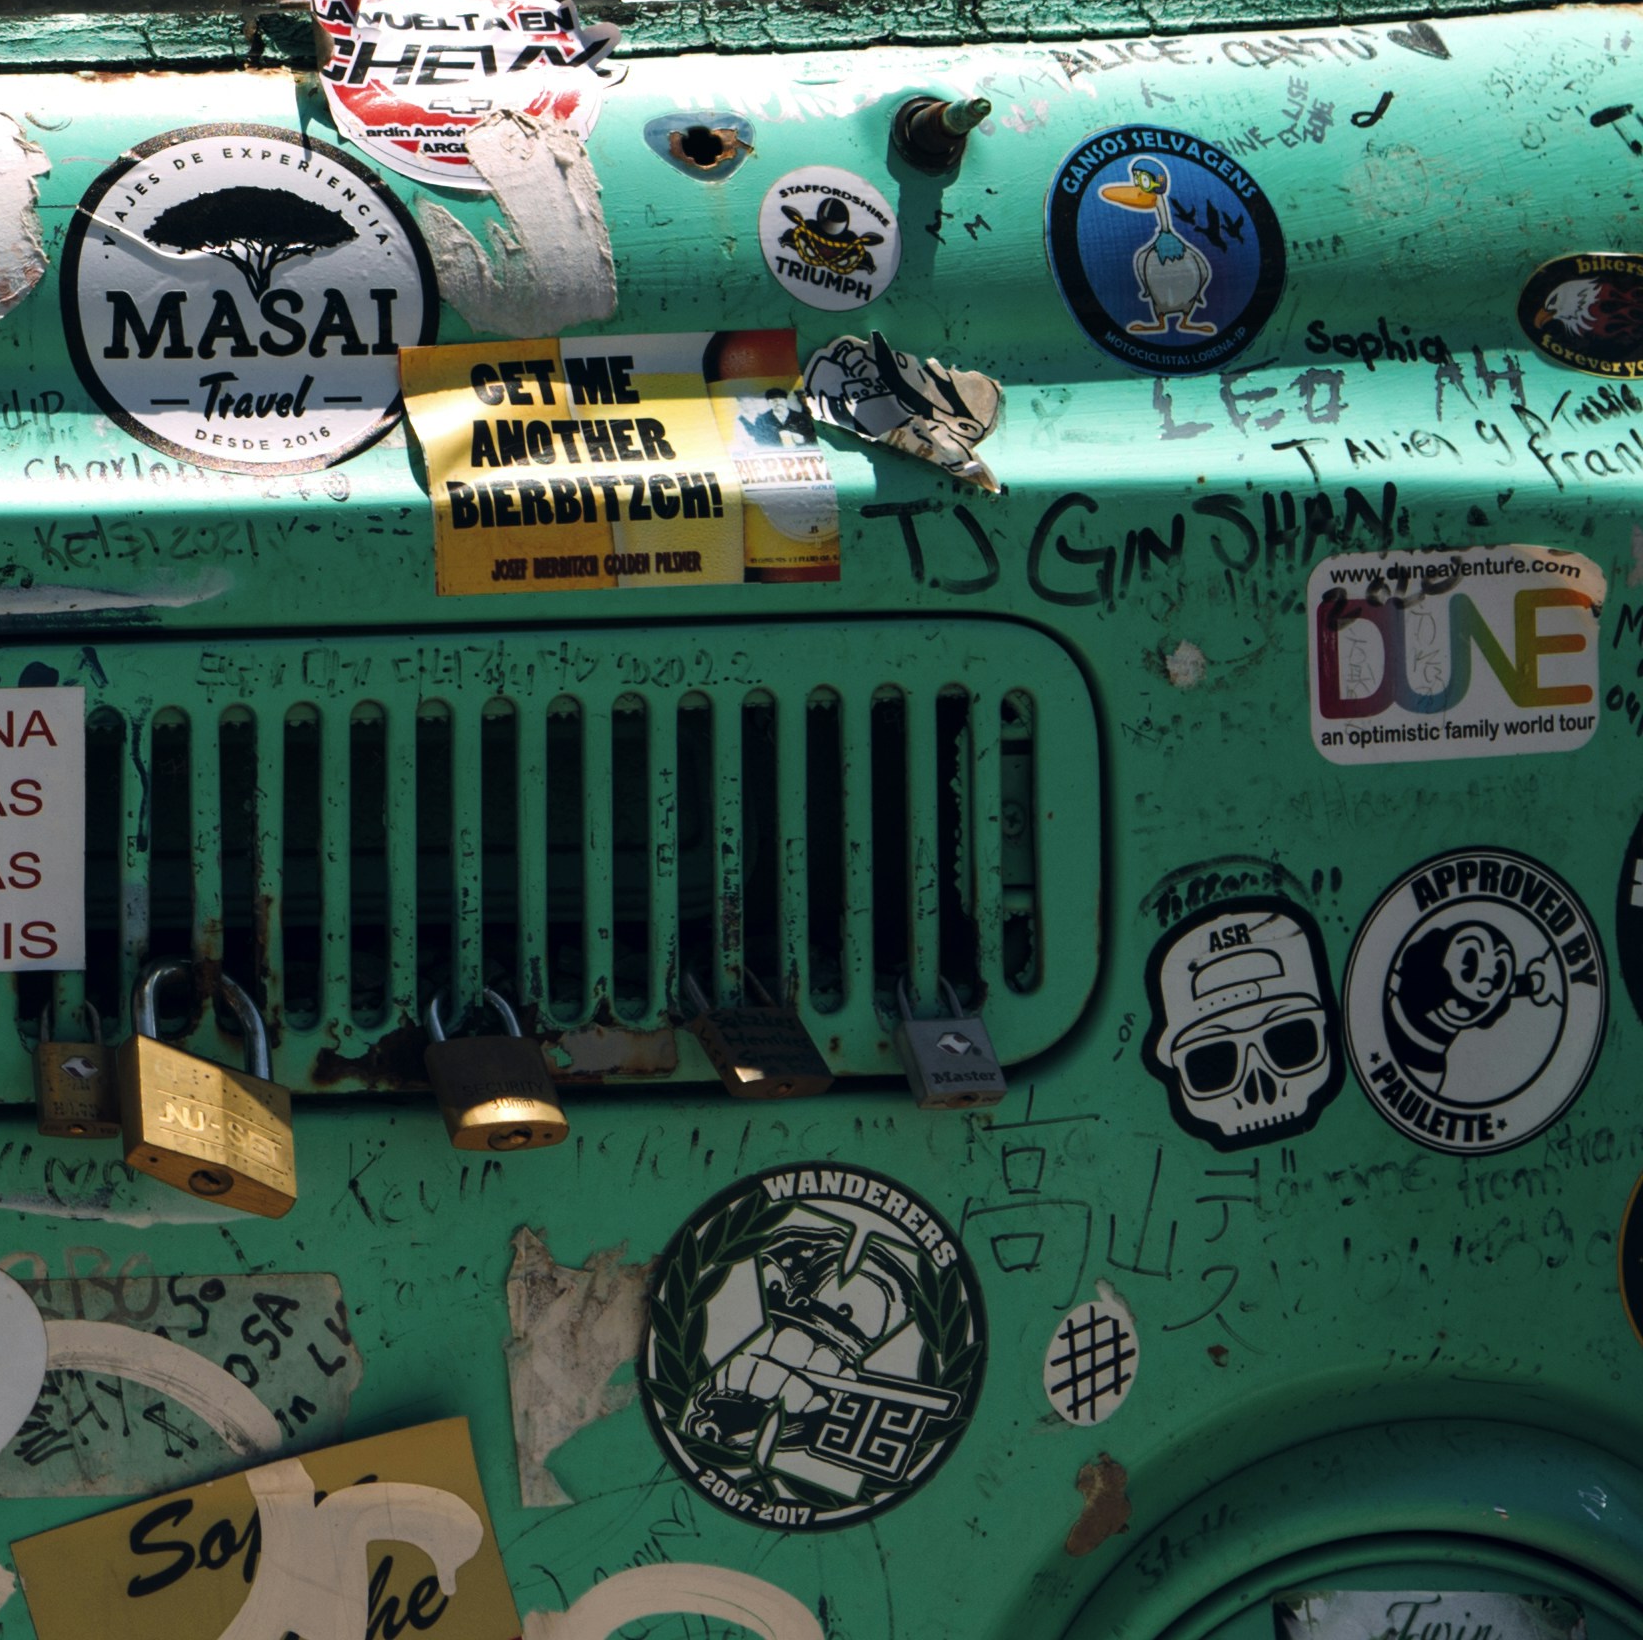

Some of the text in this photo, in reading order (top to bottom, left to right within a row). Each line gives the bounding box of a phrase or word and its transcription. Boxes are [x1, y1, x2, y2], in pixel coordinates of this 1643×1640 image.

[774, 256, 873, 302] TRIUMPH
[103, 287, 400, 360] MASAI
[199, 372, 315, 421] Travel
[471, 355, 639, 407] GET ME
[194, 425, 332, 453] DESDE 2016
[471, 418, 677, 469] ANOTHER
[446, 472, 724, 531] BIERBITZCH!
[1330, 558, 1581, 584] www.duneaventure.com
[1317, 588, 1594, 719] DUNE
[1322, 715, 1596, 748] an optimistic family world tour
[1210, 923, 1252, 954] ASR
[931, 1064, 998, 1086] Master
[1373, 1061, 1497, 1144] PAULETTE
[762, 1171, 958, 1267] WANDERERS
